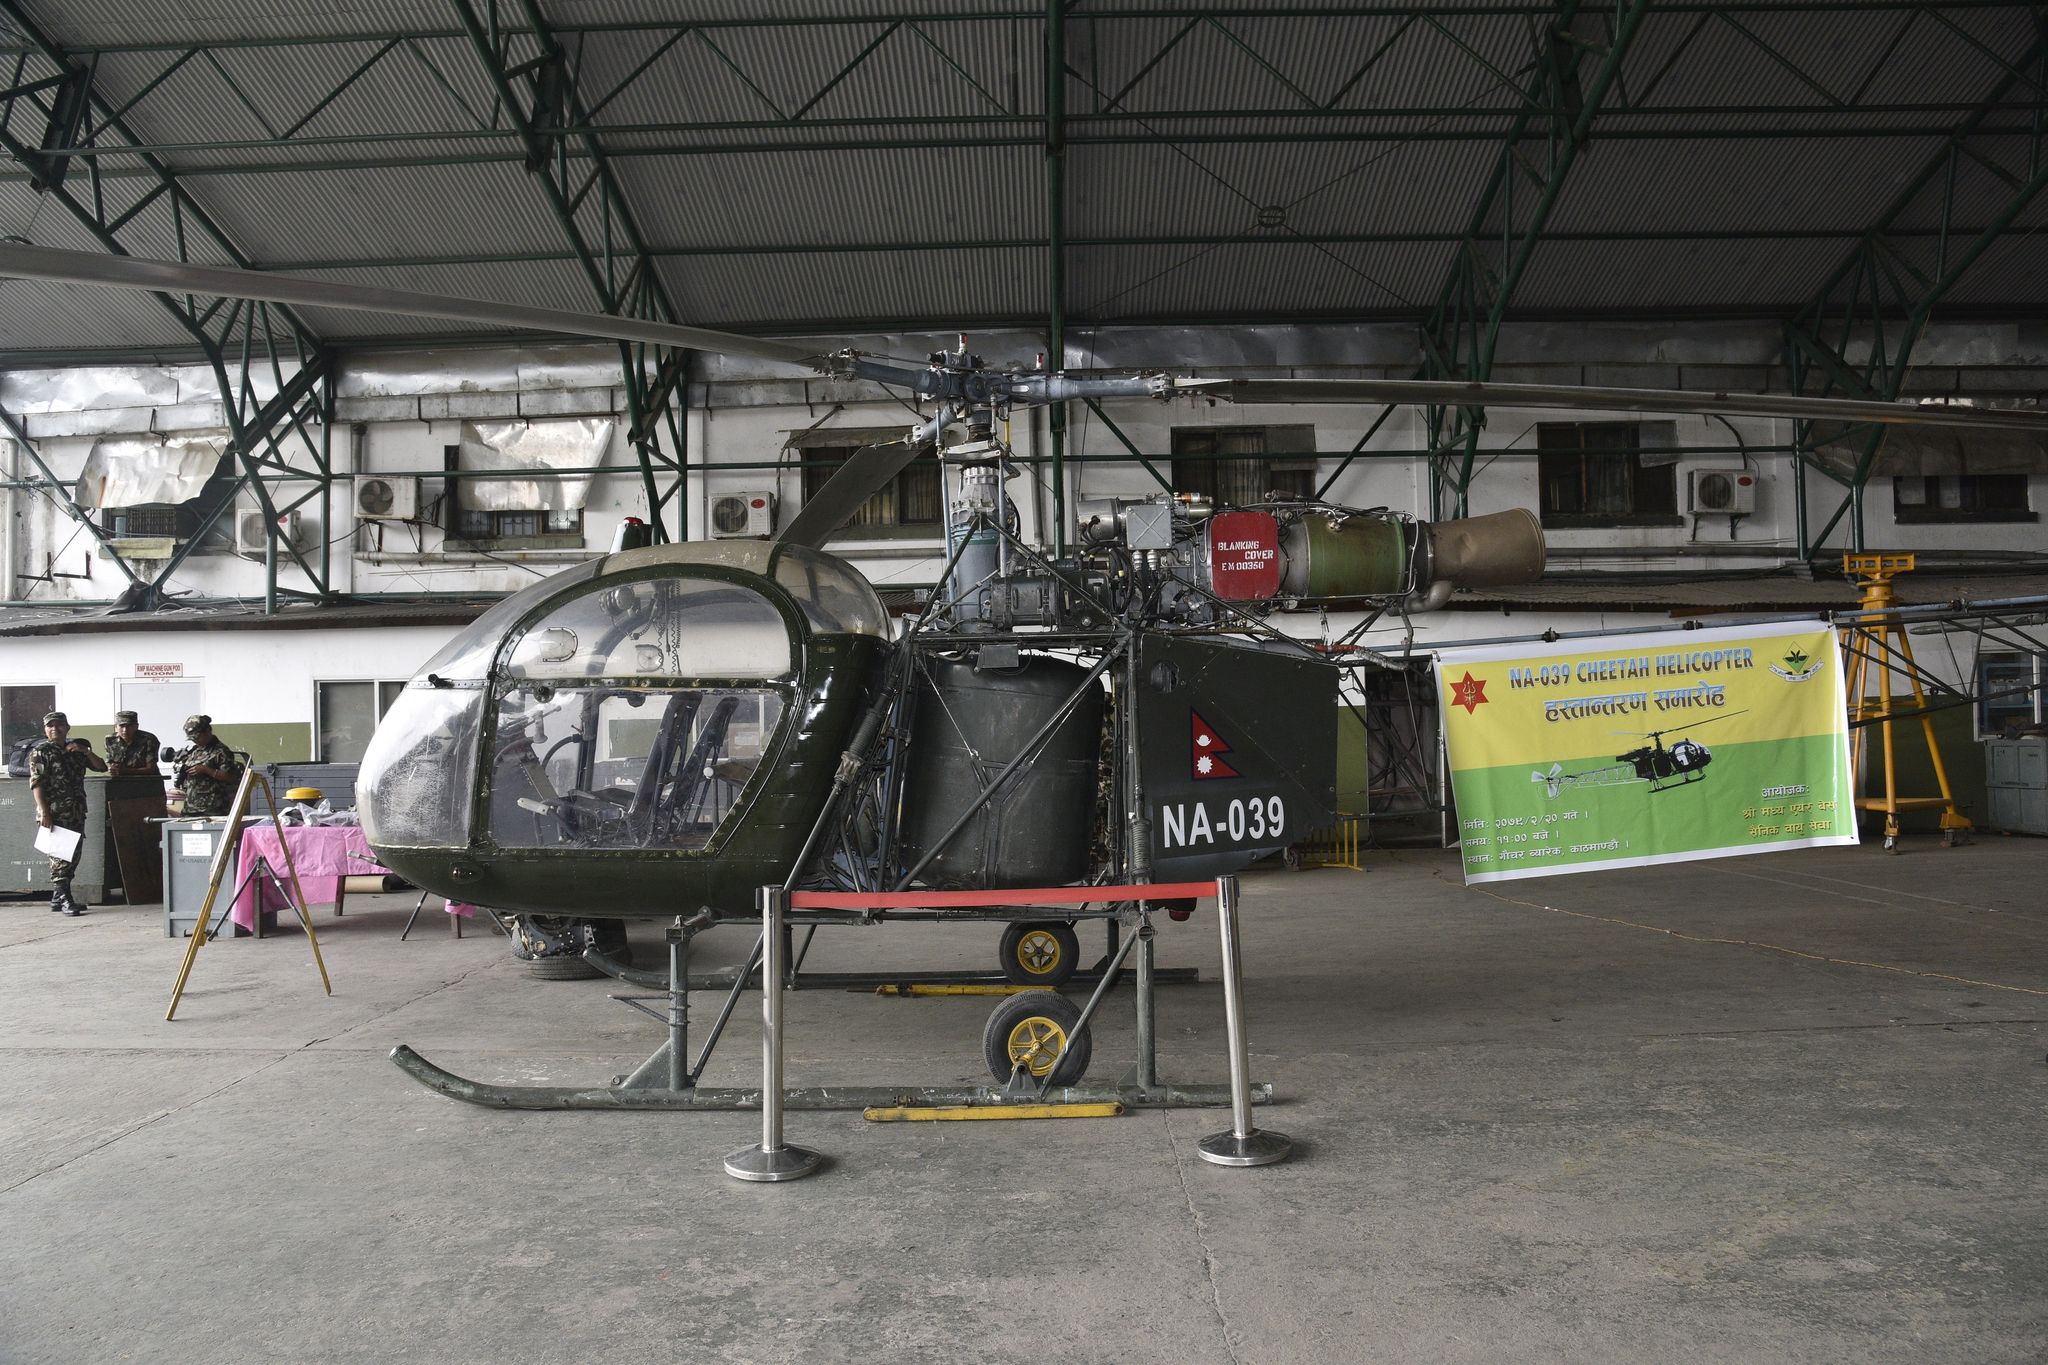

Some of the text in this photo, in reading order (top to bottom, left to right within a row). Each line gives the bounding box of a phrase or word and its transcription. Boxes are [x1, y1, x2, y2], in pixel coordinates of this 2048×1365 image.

[1218, 541, 1259, 551] BLANKING
[1245, 550, 1274, 560] COVER
[1509, 663, 1571, 689] NA-039
[1576, 656, 1650, 683] CHEETAH
[1655, 647, 1754, 676] HELICOPTER
[1544, 680, 1726, 723] हस्तान्तरण समारोह
[1163, 795, 1285, 848] NA-039
